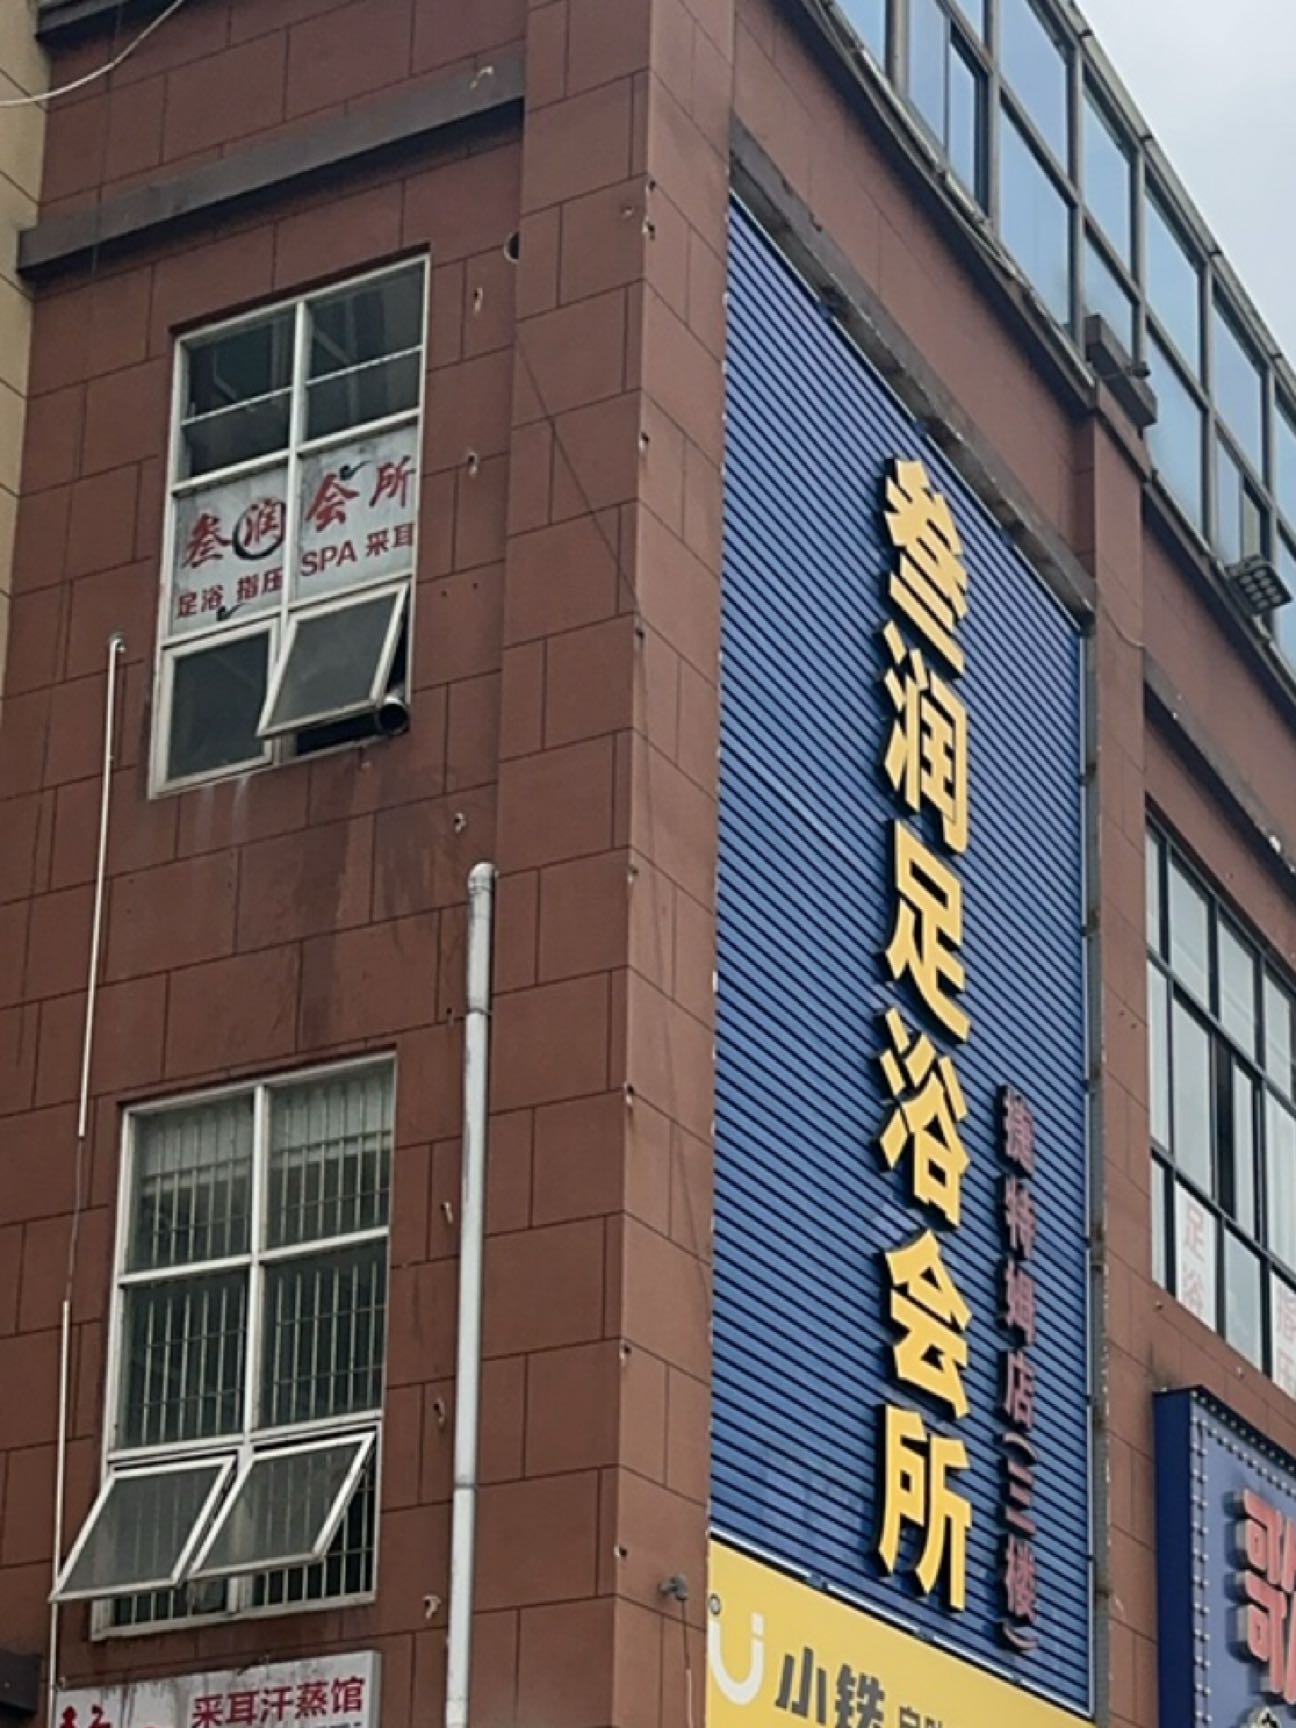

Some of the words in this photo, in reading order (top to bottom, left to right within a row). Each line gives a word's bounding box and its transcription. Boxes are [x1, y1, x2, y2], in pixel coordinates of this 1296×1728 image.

[300, 540, 358, 576] SPA
[875, 456, 973, 1614] 叁润足浴会所
